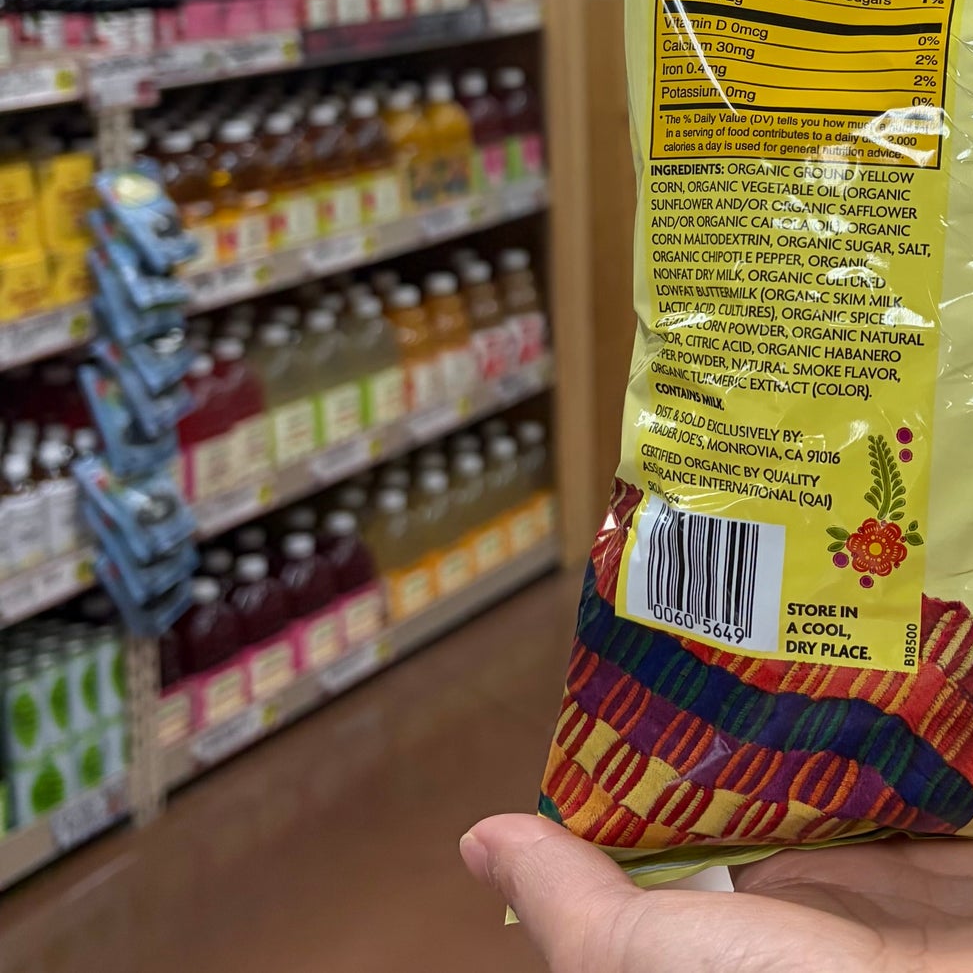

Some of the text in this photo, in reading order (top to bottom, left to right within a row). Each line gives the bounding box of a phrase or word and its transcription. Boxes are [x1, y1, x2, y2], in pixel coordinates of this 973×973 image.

[731, 22, 768, 40] 0mcg
[662, 63, 683, 75] Iron
[752, 128, 809, 140] contributes
[650, 164, 915, 184] INGREDIENTS: ORGANIC YELLOW
[650, 180, 911, 202] CORN, ORGANIC VEGETABLE OIL (ORGANIC
[651, 198, 917, 219] SUNFLOWER AND/OR SAFFLOWER
[651, 233, 931, 258] CORN MALTODEXTRIN, ORGANIC SUGAR, SALT,
[652, 250, 804, 268] ORGANIC PEPPER,
[653, 267, 812, 285] NONFAT DRY ORGANIC
[656, 285, 865, 306] LOWFAT BUTTERMILK SKIM
[718, 304, 779, 321] CULTURES),
[685, 335, 901, 362] CITRIC ACID, ORGANIC HABANERO
[860, 331, 925, 346] NATURAL
[677, 351, 901, 382] POWDER, SMOKE FLAVOR,
[655, 382, 725, 411] CONTAINS MILK.
[812, 383, 872, 399] (COLOR).
[680, 411, 803, 443] SOLD EXCLUSIVELY BY:
[677, 430, 841, 465] JOE'S, MONROVIA, CA 91016
[641, 443, 821, 488] CERTIFIED ORGANIC QUALITY
[699, 475, 796, 503] INTERNATIONAL
[799, 492, 833, 511] (QAI)
[787, 602, 858, 619] STORE IN
[786, 622, 852, 640] A COOL,
[786, 641, 872, 661] DRY PLACE.
[904, 623, 918, 667] B18500
